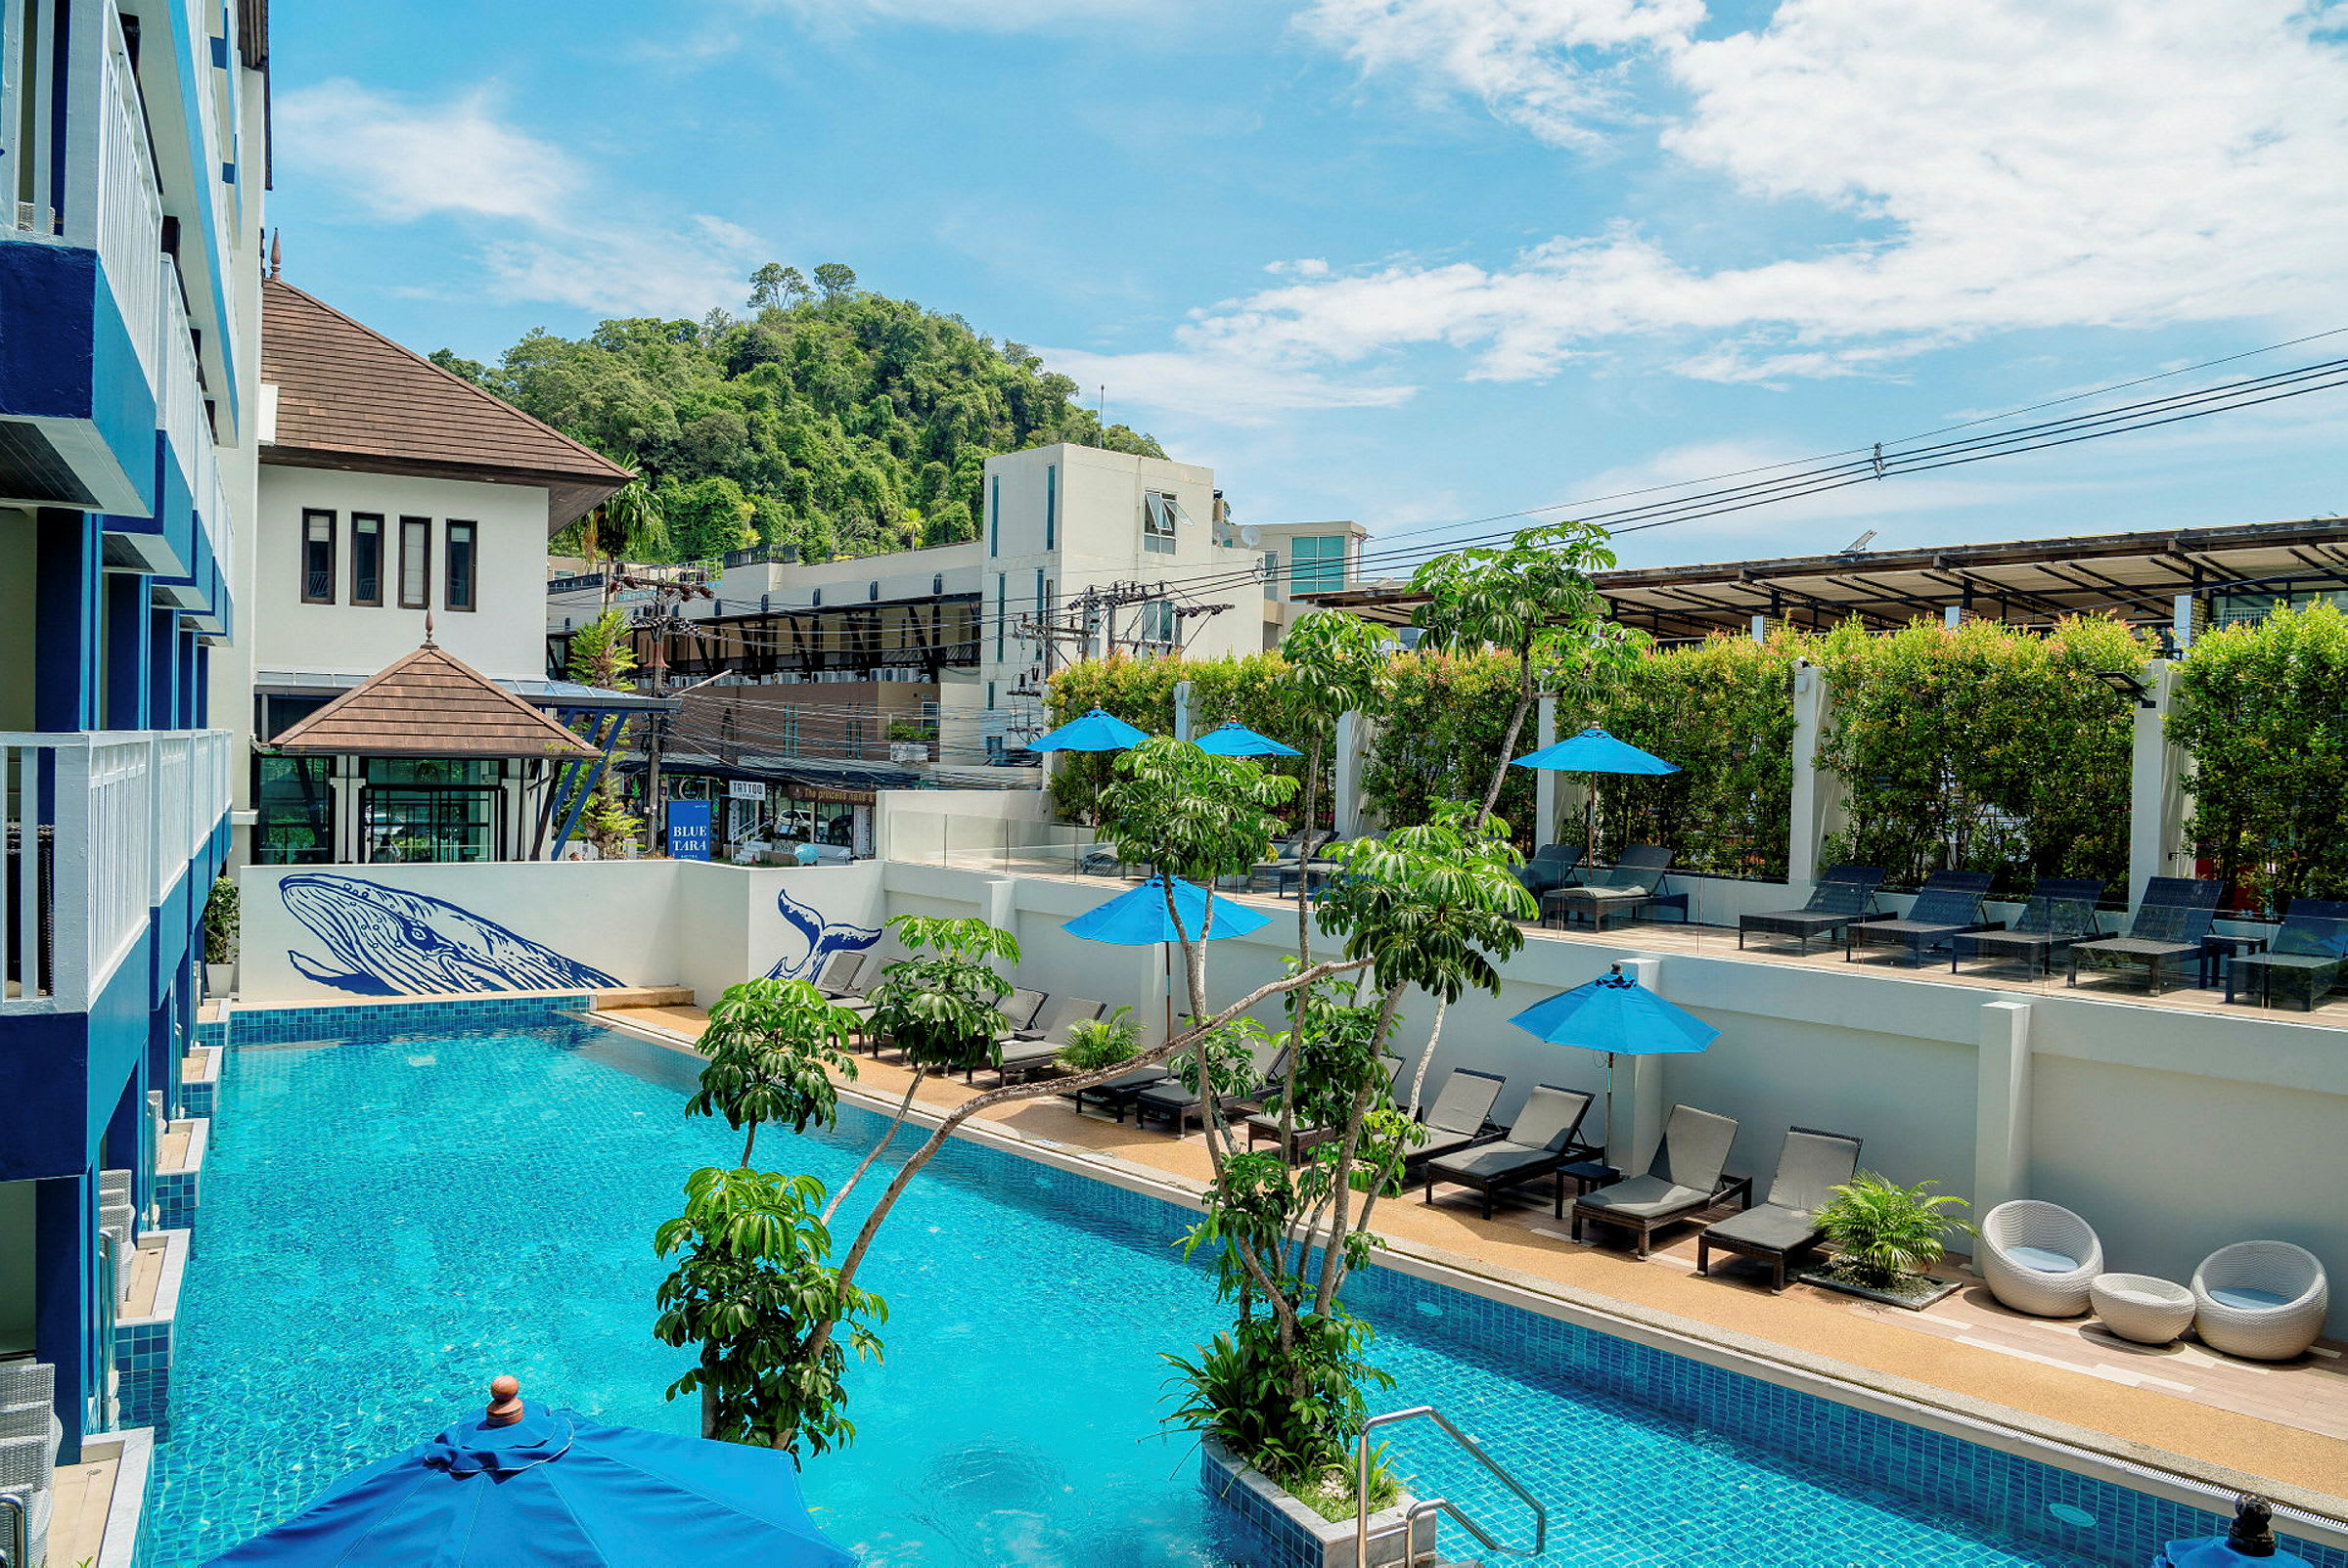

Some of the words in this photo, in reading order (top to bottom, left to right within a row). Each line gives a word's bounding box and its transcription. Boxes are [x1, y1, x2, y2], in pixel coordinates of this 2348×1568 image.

[733, 783, 763, 794] TATTOO
[673, 826, 707, 837] BLUE
[672, 840, 706, 851] TARA
